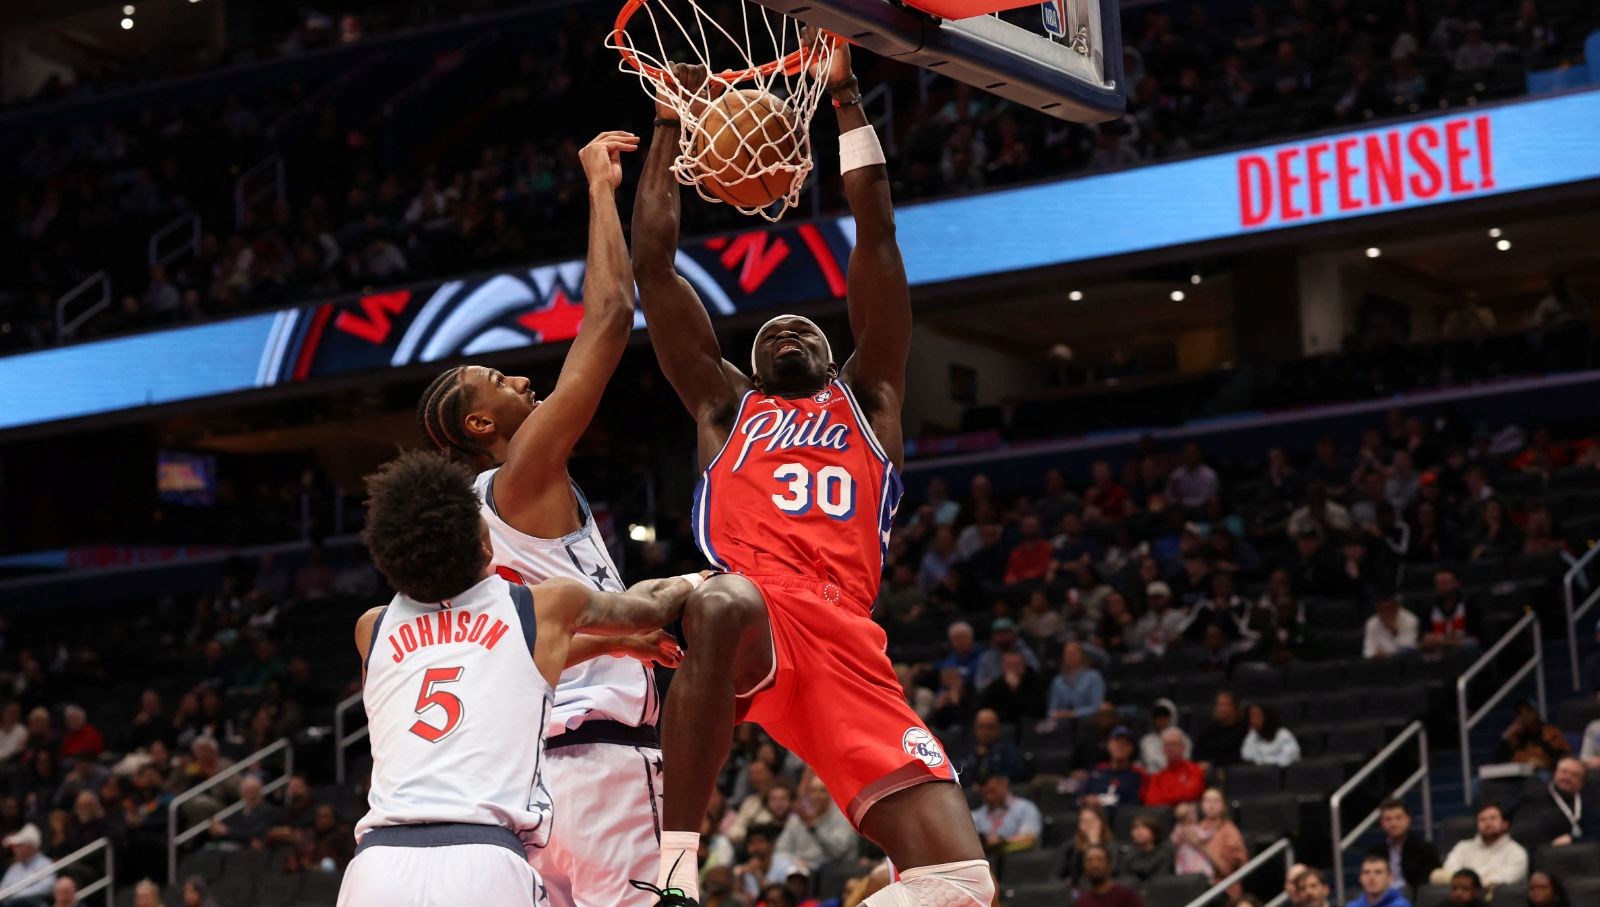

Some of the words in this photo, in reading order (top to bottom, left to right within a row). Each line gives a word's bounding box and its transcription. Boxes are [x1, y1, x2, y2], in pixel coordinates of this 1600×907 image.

[1044, 7, 1058, 28] NBA
[1236, 115, 1495, 229] DEFENSE!
[732, 407, 851, 473] Phila
[771, 462, 857, 522] 30
[388, 610, 510, 664] JOHNSON
[408, 666, 465, 744] 5
